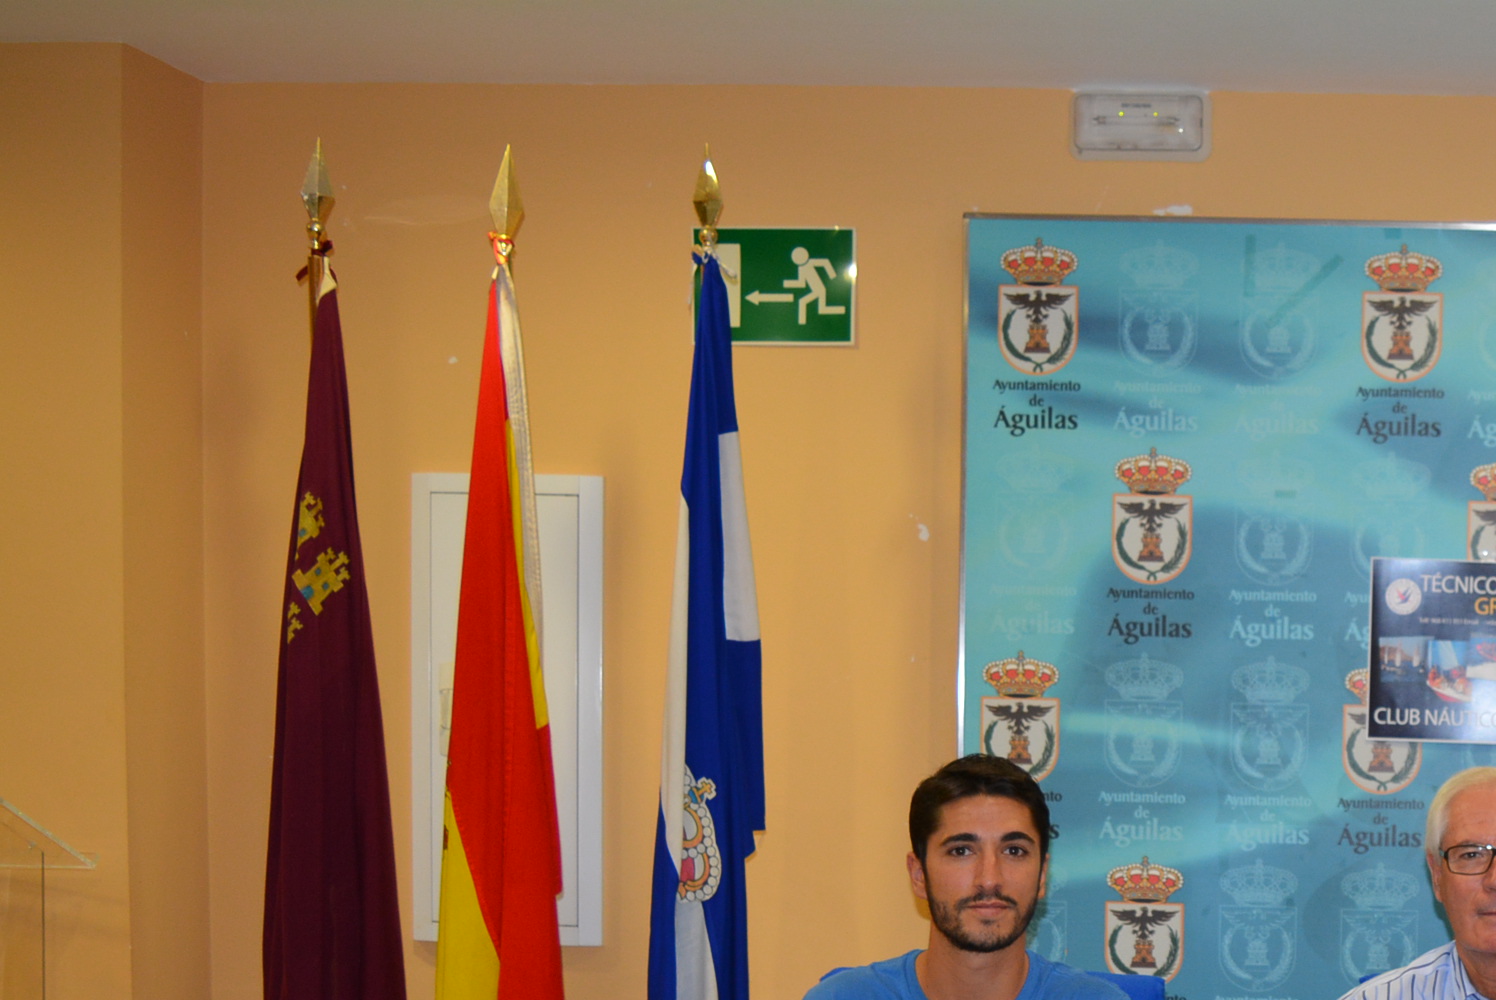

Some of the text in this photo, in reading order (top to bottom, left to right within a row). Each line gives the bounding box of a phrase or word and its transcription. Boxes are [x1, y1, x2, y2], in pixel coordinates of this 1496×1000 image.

[993, 379, 1080, 394] Ayuntamiento
[1356, 386, 1444, 400] Ayuntamiento
[1029, 393, 1044, 406] de
[1392, 399, 1408, 412] de
[994, 406, 1078, 436] Águilas
[1356, 412, 1441, 444] Águilas
[1107, 586, 1194, 602] Ayuntamiento
[1229, 589, 1316, 604] Ayuntamiento
[1144, 601, 1159, 613] de
[1265, 604, 1280, 616] de
[1107, 614, 1192, 644] Águilas
[1230, 616, 1314, 646] Águilas
[1374, 708, 1420, 726] CLUB
[1098, 790, 1186, 806] Ayuntamiento
[1226, 793, 1312, 808] Ayuntamiento
[1337, 797, 1424, 812] Ayuntamiento
[1134, 804, 1149, 816] de
[1260, 808, 1275, 820] de
[1373, 812, 1388, 823] de
[1099, 816, 1183, 846] Águilas
[1226, 819, 1309, 850] Águilas
[1337, 823, 1422, 854] Águilas
